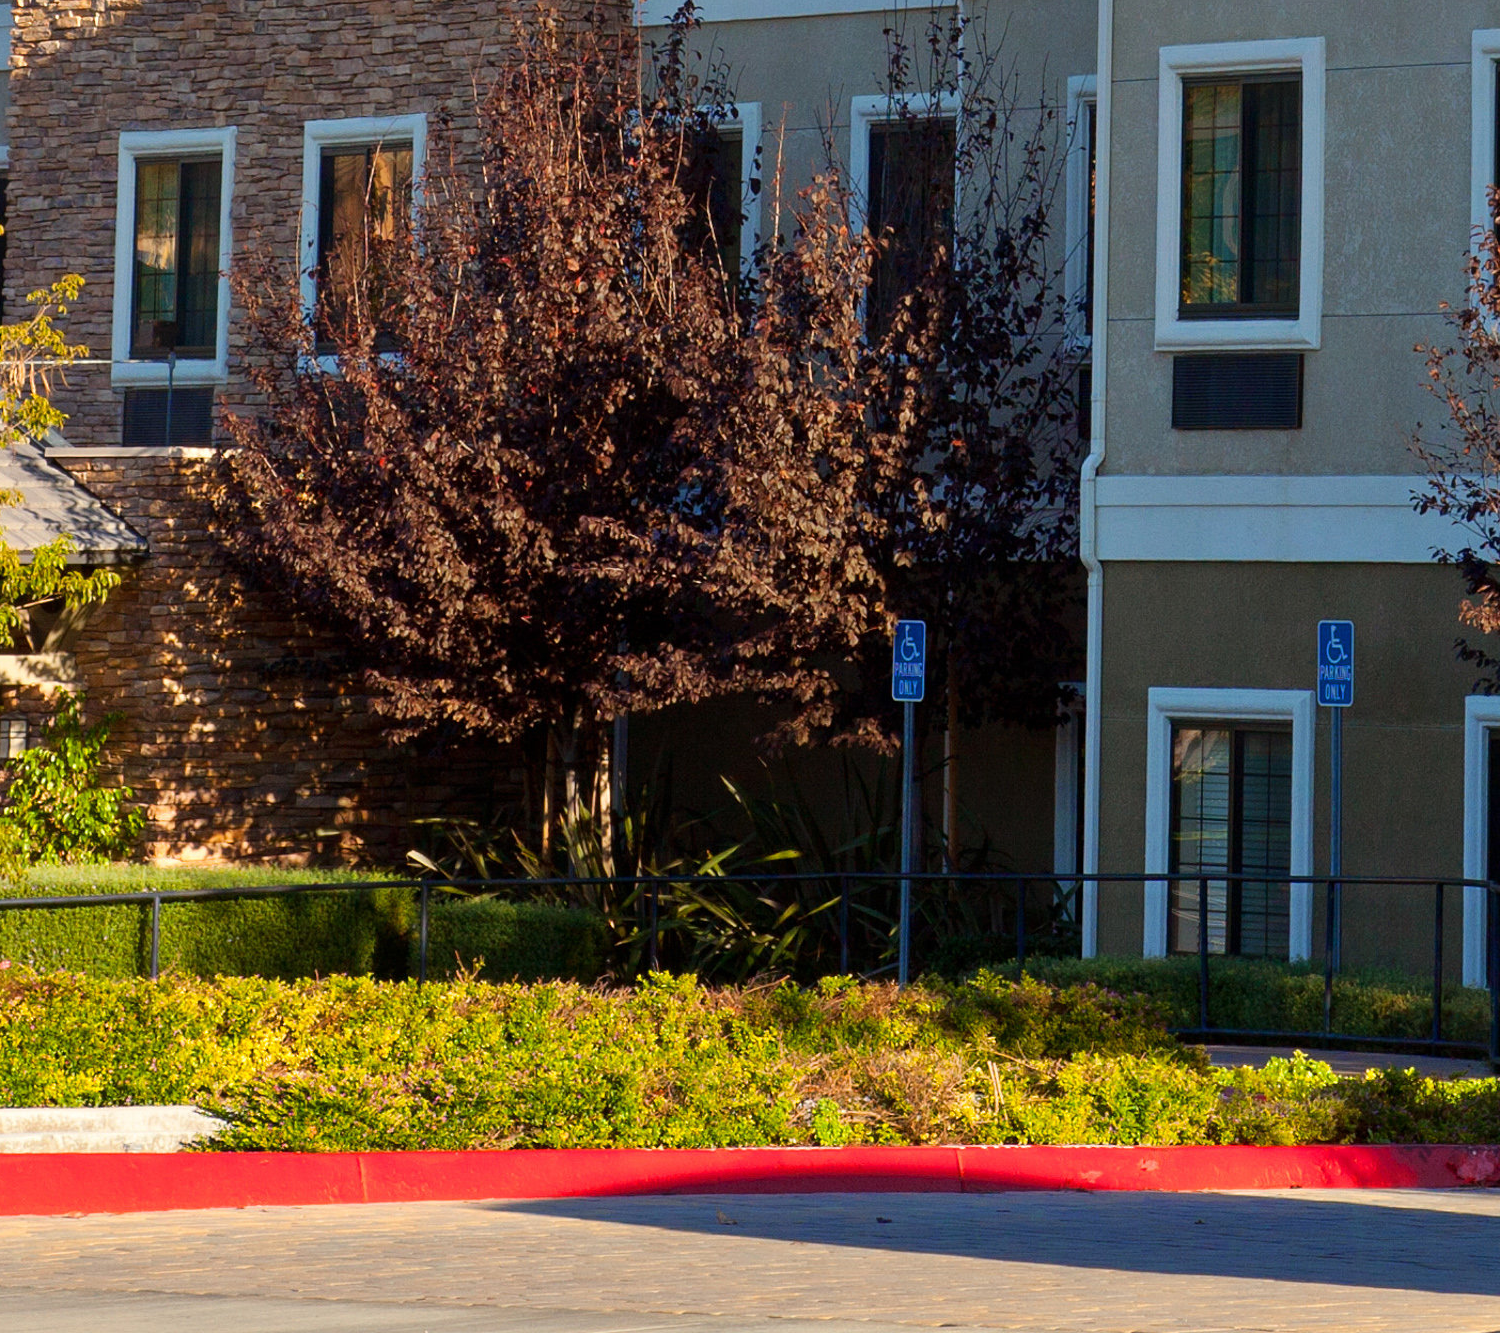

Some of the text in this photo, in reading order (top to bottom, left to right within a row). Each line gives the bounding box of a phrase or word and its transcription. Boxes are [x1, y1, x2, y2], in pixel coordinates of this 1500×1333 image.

[894, 662, 923, 677] PARKING
[1320, 665, 1351, 681] PARKING
[899, 680, 918, 695] ONLY
[1324, 683, 1346, 700] ONLY
